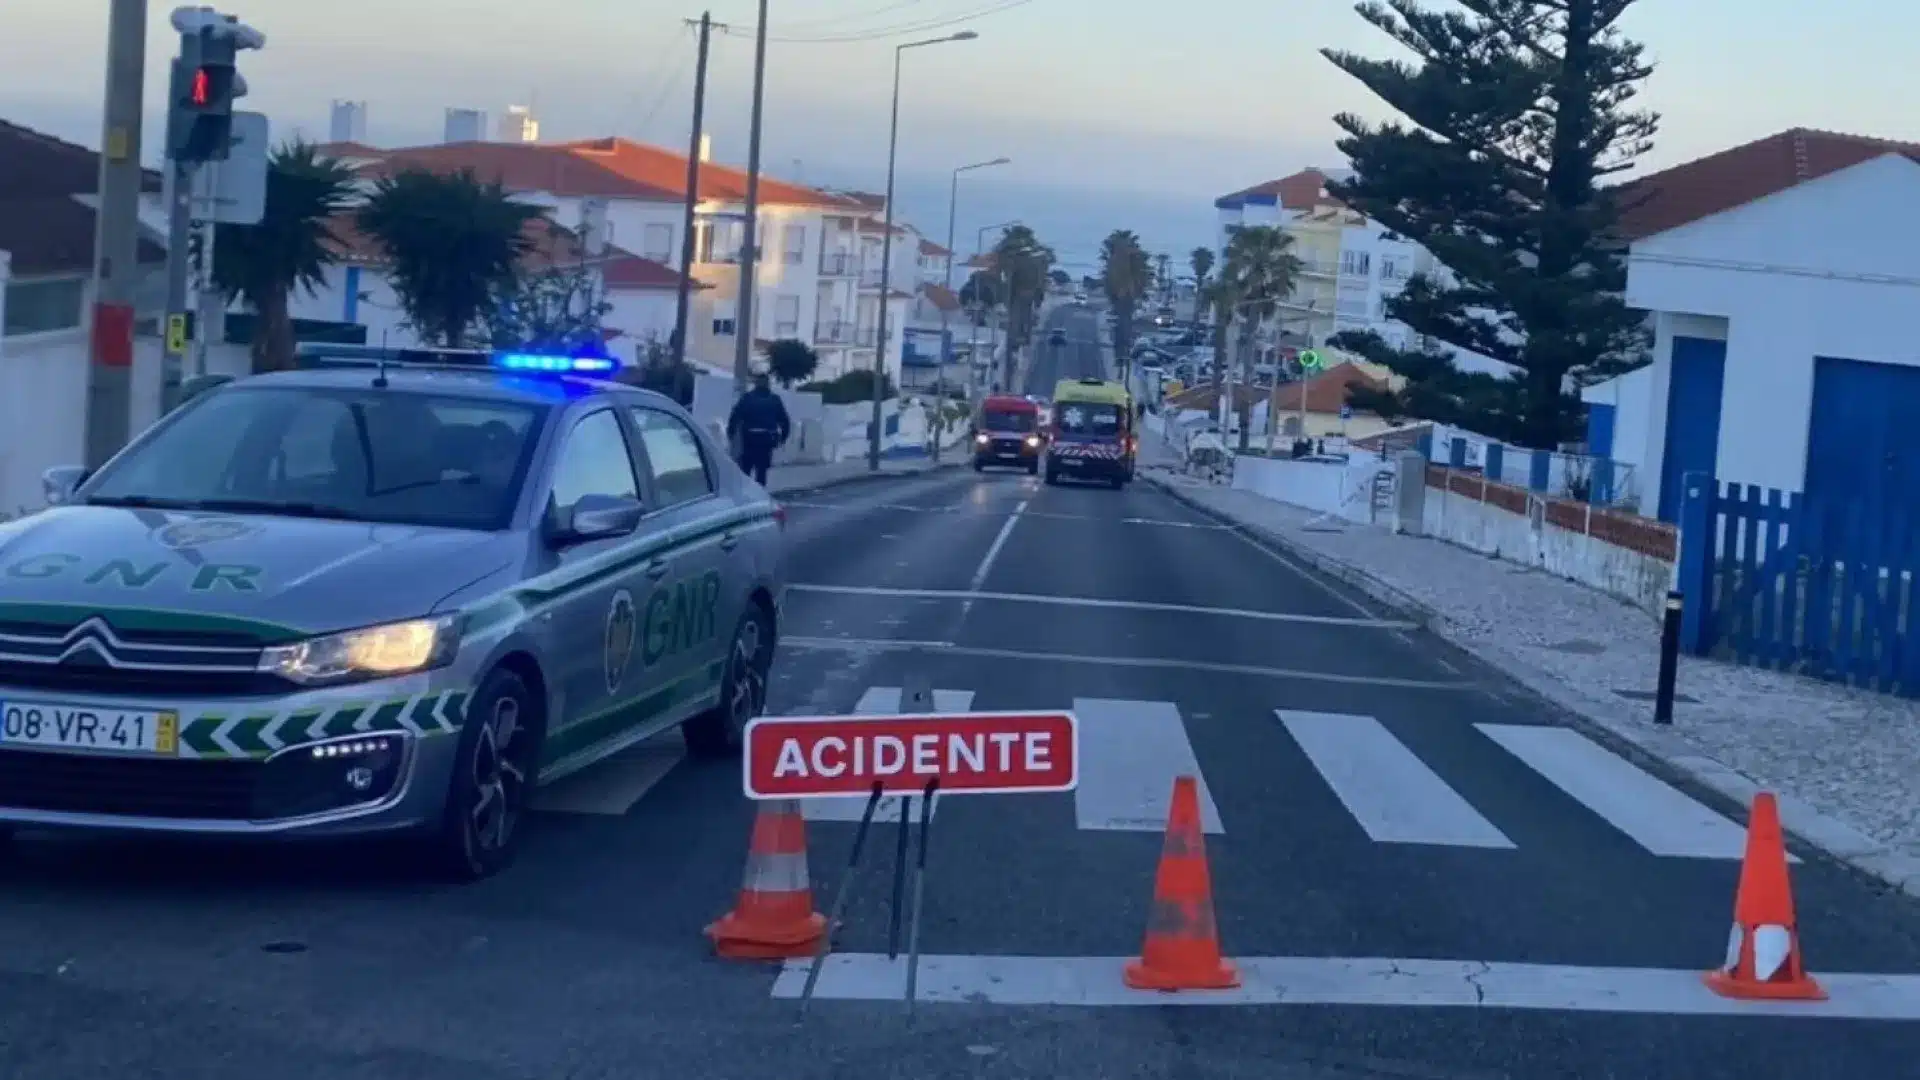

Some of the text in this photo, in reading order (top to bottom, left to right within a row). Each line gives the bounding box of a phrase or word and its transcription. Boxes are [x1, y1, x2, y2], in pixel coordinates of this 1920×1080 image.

[6, 553, 263, 589] GNR
[643, 570, 720, 667] GNR
[773, 732, 1052, 777] ACIDENTE
